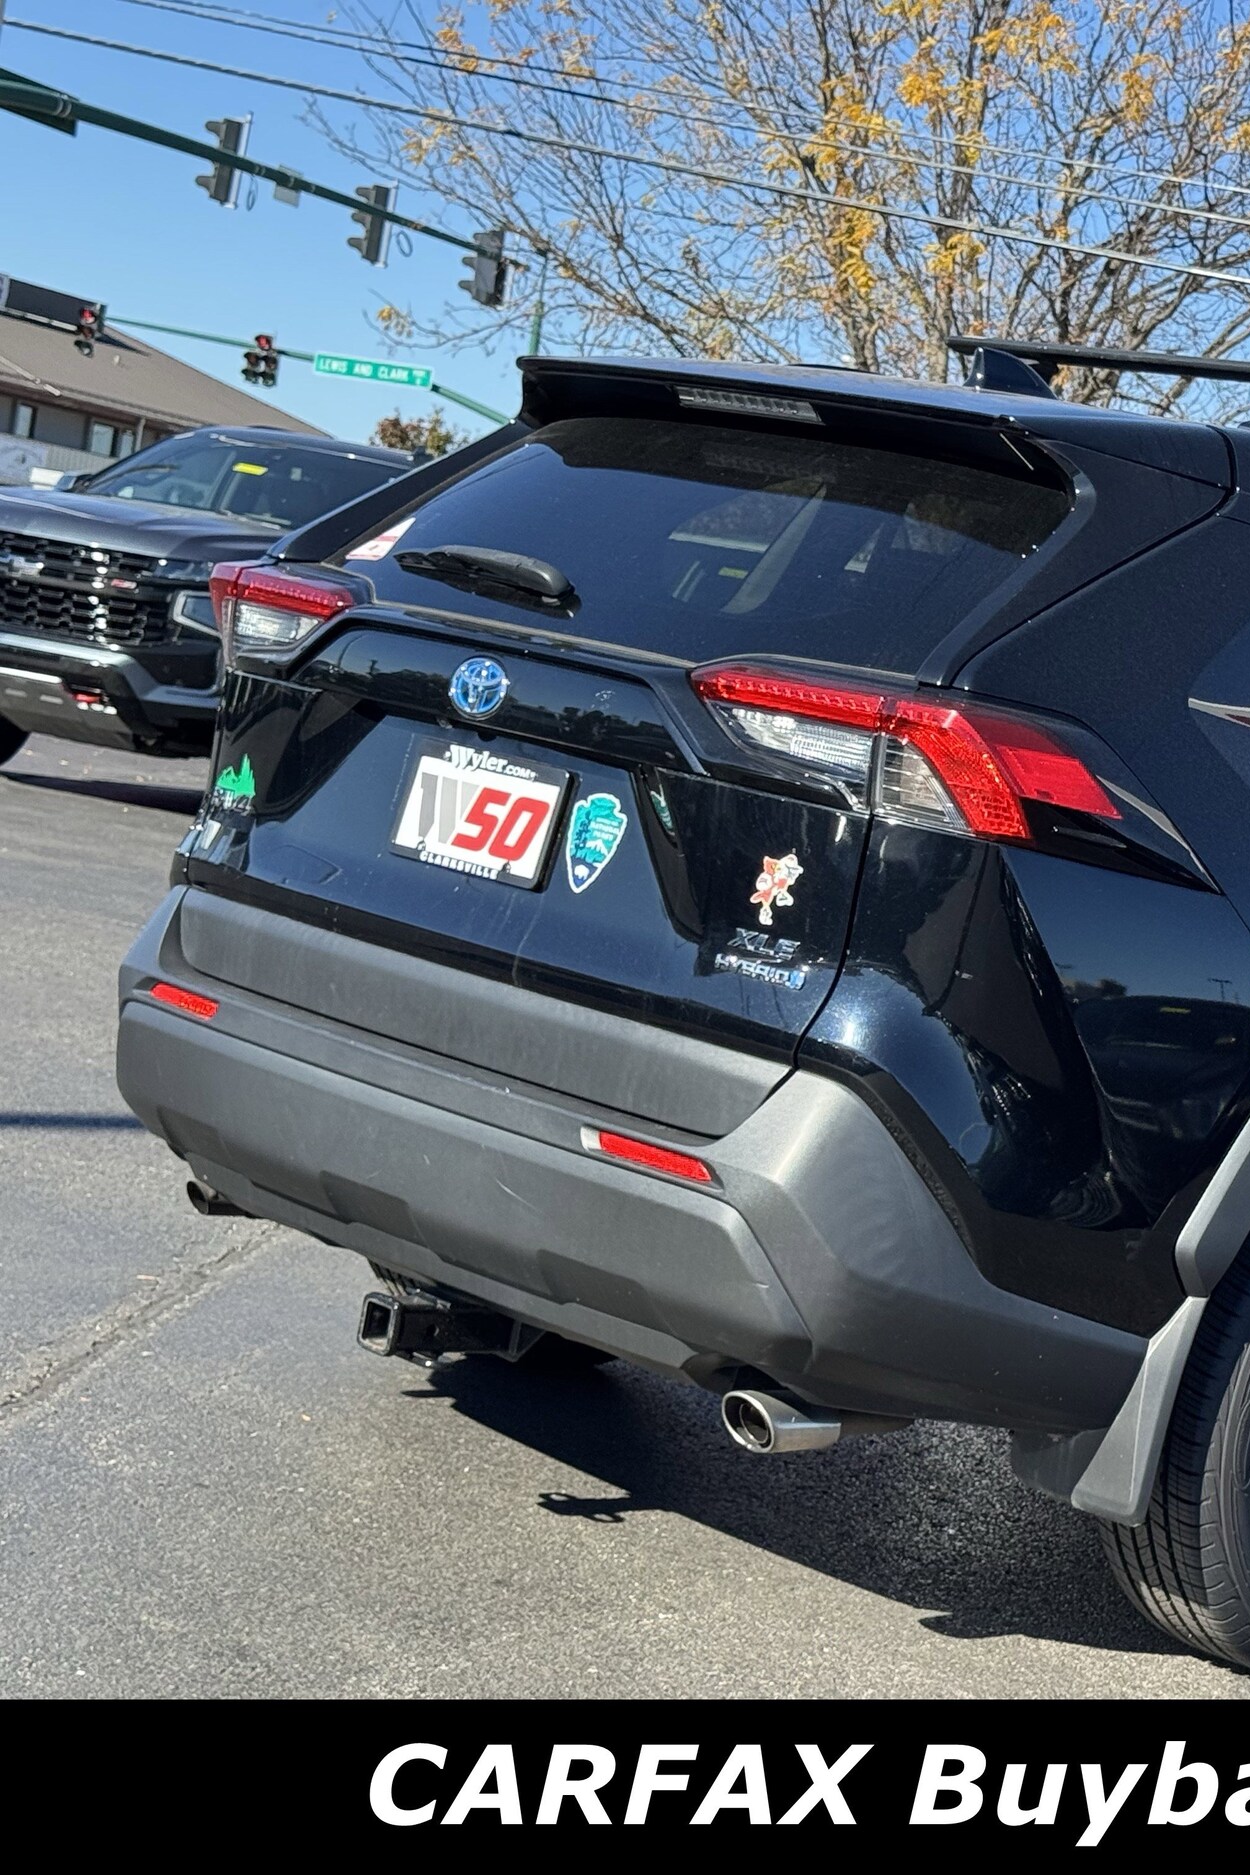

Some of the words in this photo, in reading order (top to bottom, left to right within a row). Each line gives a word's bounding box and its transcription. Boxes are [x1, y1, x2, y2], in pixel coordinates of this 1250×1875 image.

[320, 358, 348, 373] LEWIS
[352, 362, 373, 377] AND
[378, 366, 409, 381] CLARK
[450, 786, 550, 861] 50
[419, 851, 498, 880] CLARKSVILLE
[727, 927, 801, 961] XLE
[714, 953, 791, 984] HYBRID
